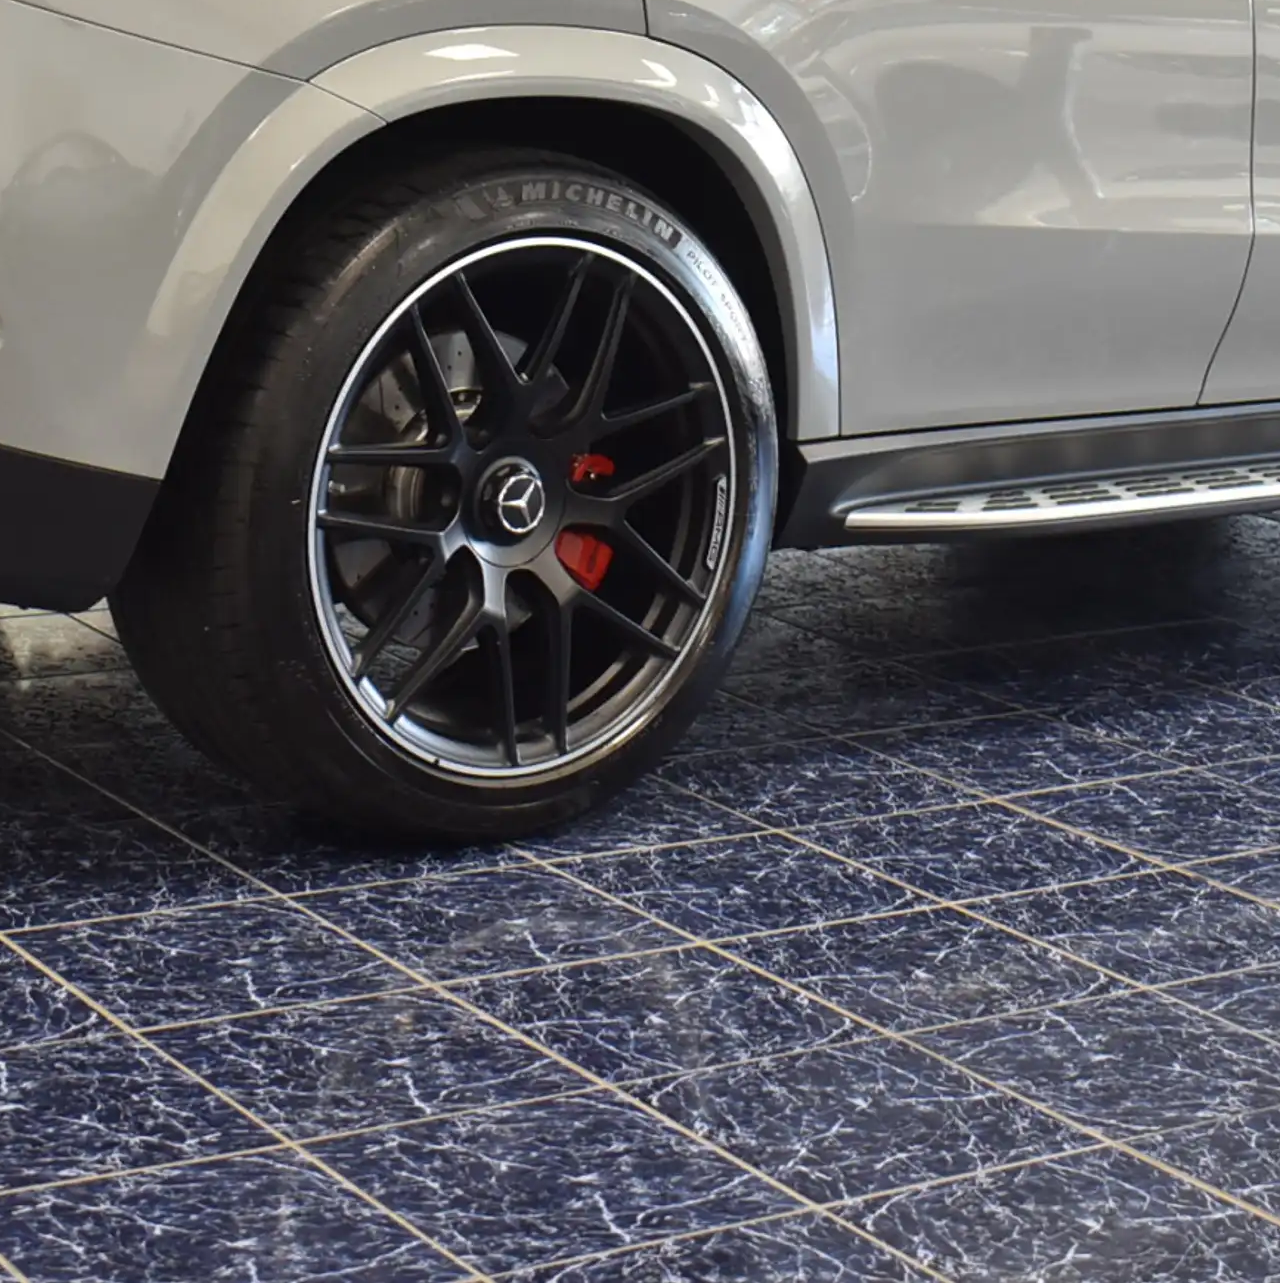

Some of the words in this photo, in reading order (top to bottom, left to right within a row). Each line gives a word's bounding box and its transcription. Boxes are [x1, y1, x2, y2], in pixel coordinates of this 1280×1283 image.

[521, 180, 675, 243] MICHELIN
[686, 250, 718, 287] PILOT
[719, 292, 748, 342] SPORT
